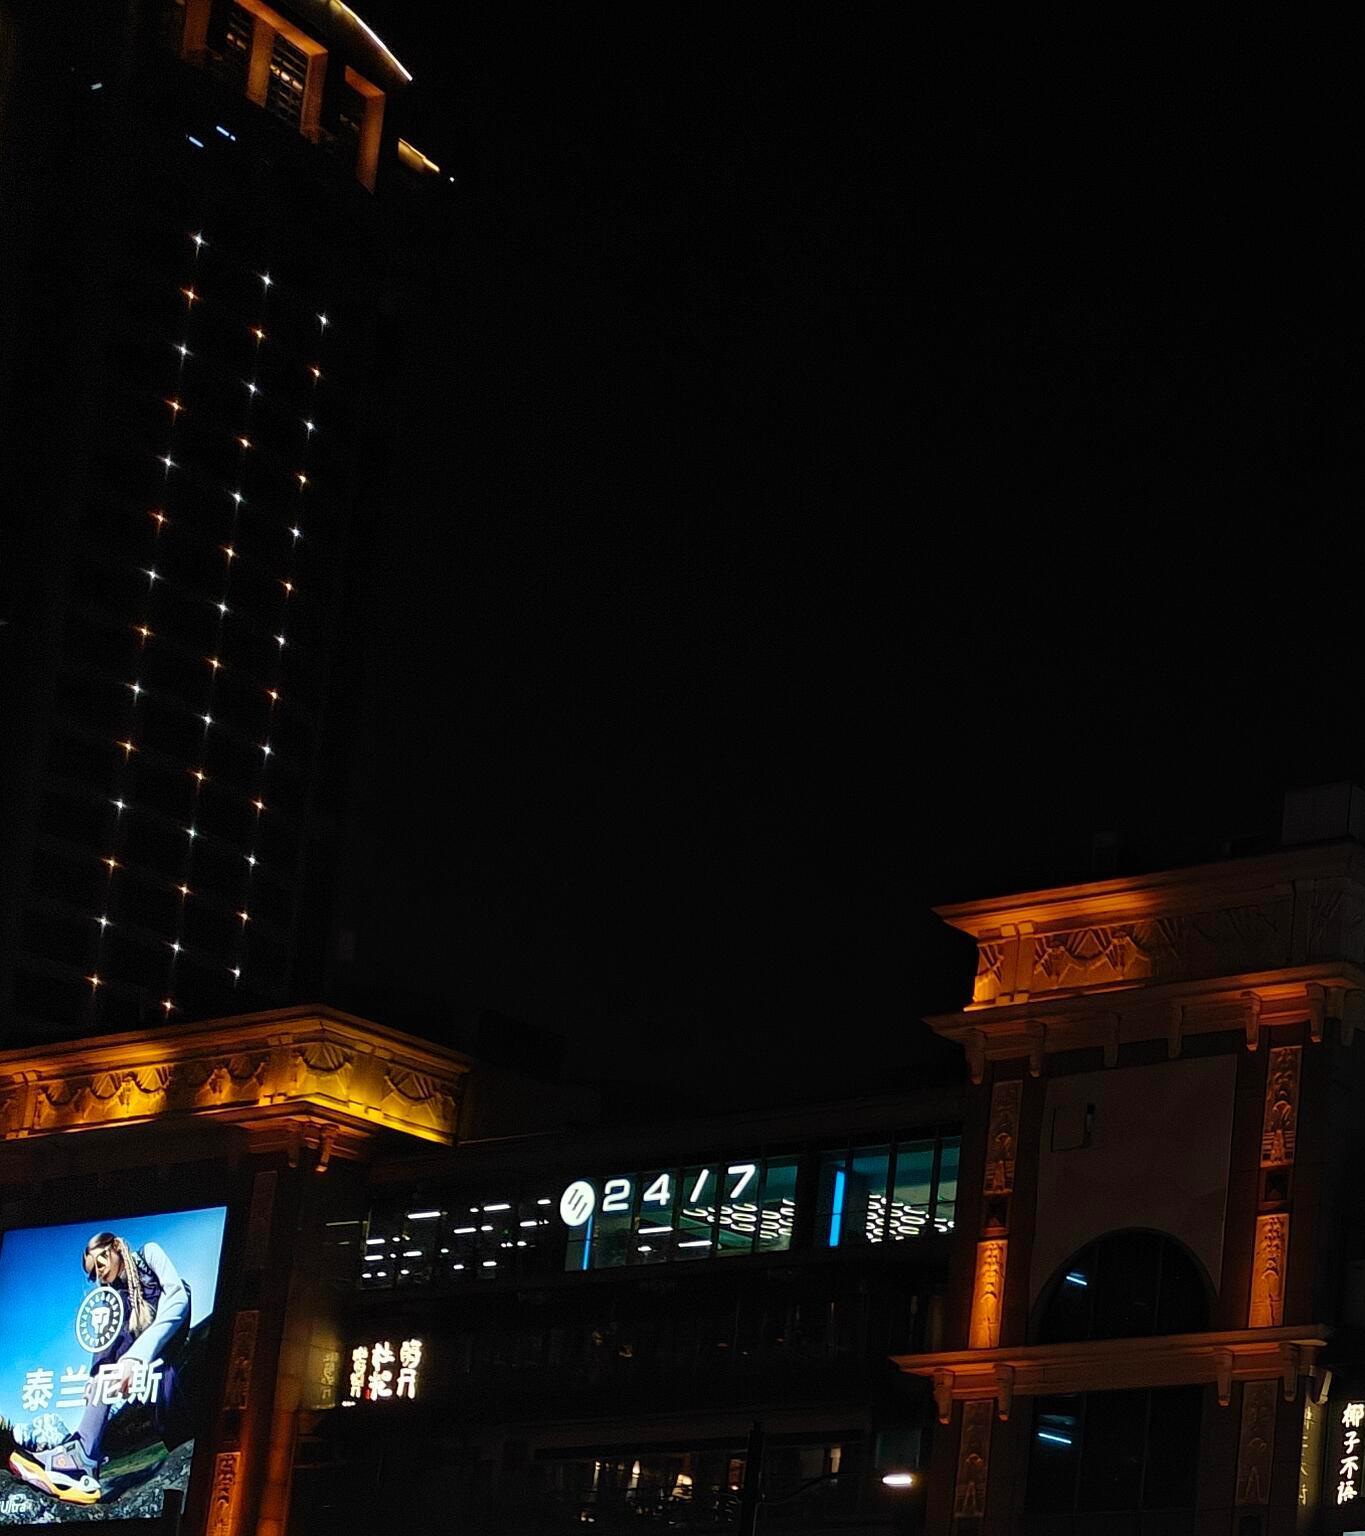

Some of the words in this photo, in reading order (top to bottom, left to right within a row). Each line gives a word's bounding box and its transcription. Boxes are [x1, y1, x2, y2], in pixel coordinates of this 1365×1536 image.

[602, 1164, 756, 1212] 24/7
[22, 1357, 165, 1412] 泰兰尼斯
